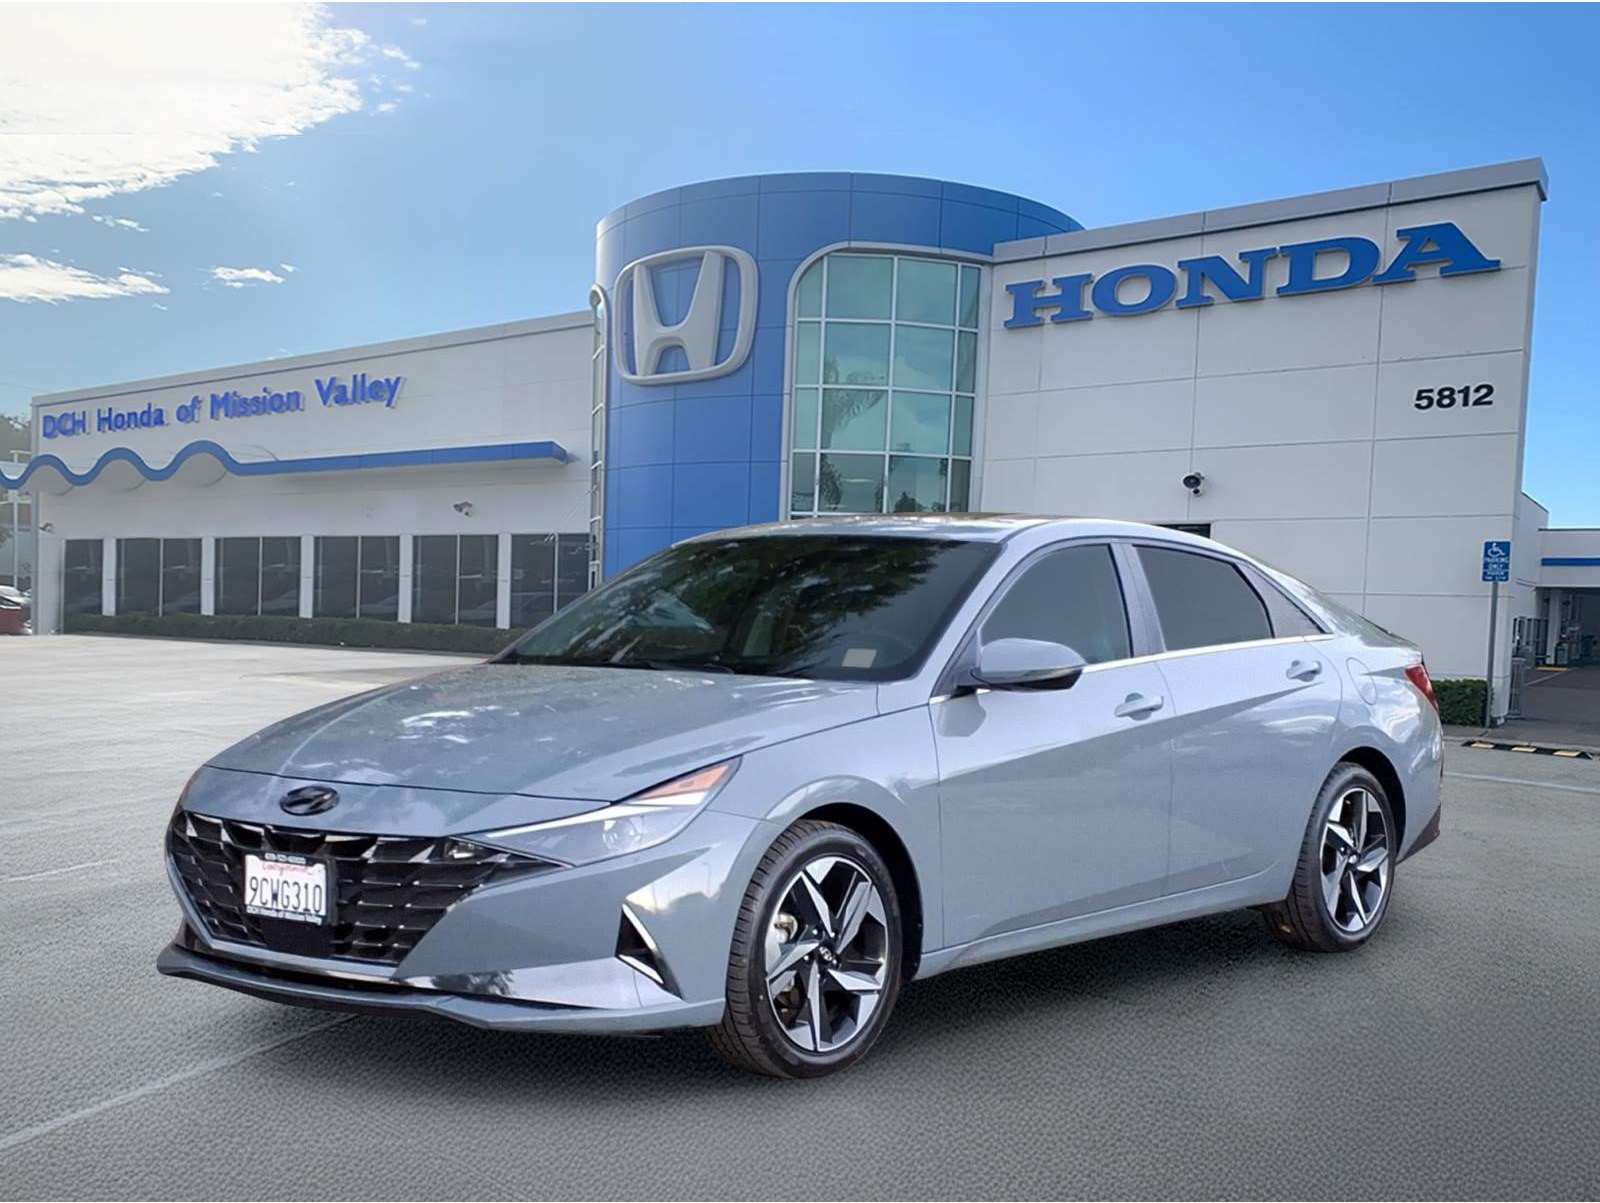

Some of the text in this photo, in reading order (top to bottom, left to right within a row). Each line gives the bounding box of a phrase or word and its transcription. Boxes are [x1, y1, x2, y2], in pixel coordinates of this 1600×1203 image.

[1004, 221, 1502, 329] HONDA
[42, 372, 405, 439] DCH Honda of Mission Valley
[1413, 383, 1495, 410] 5812
[249, 876, 323, 914] 9CWG310
